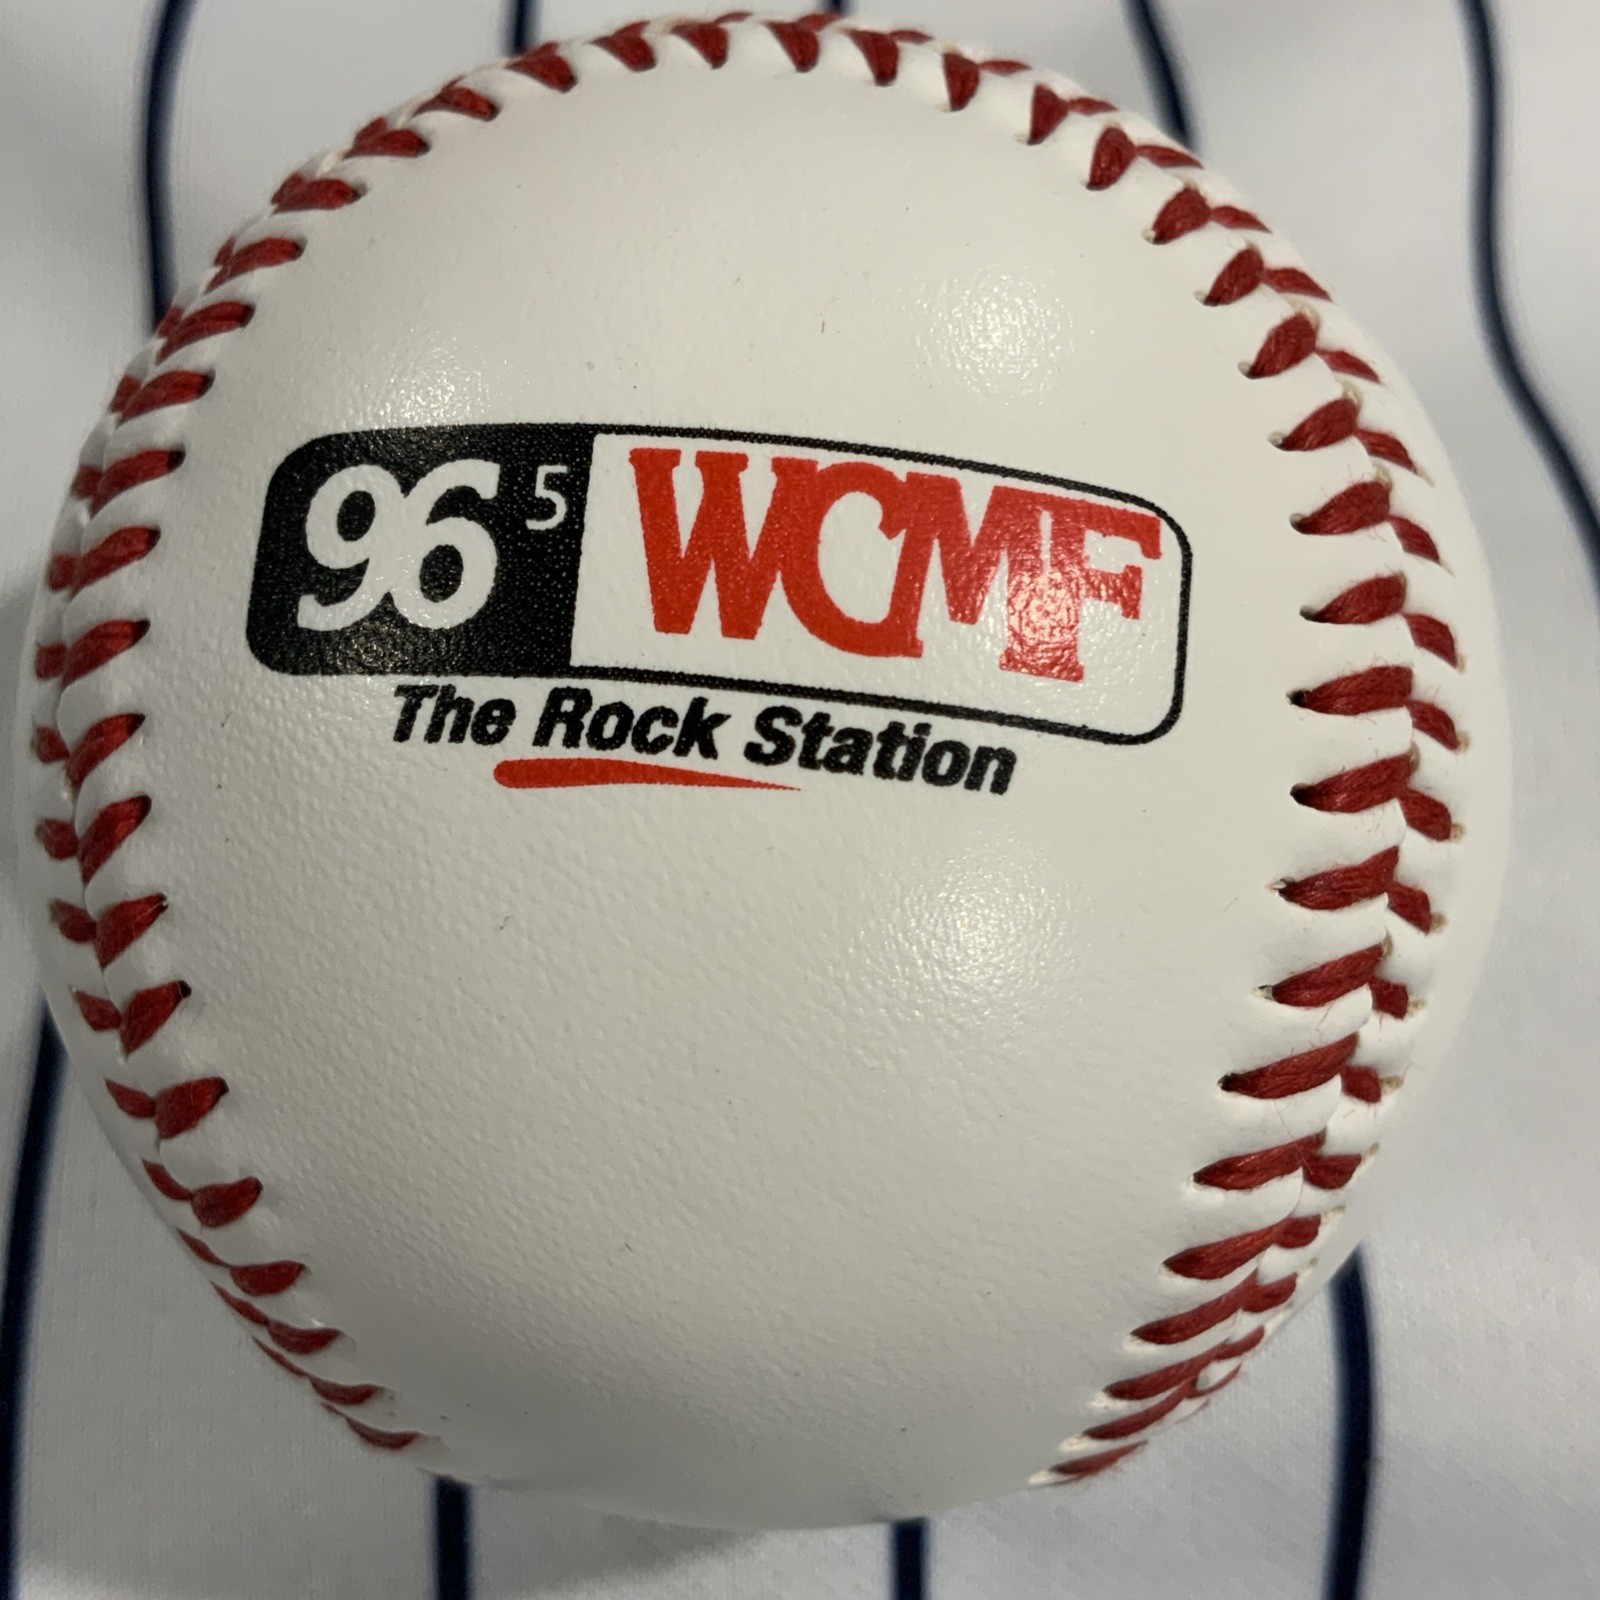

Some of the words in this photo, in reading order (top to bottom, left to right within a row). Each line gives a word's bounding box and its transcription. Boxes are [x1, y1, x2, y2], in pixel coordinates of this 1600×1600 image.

[297, 458, 501, 632] 96
[525, 463, 569, 531] 5
[628, 447, 1163, 683] WCMF
[393, 683, 516, 746] The
[532, 686, 731, 760] Rock
[743, 705, 1017, 795] Station
